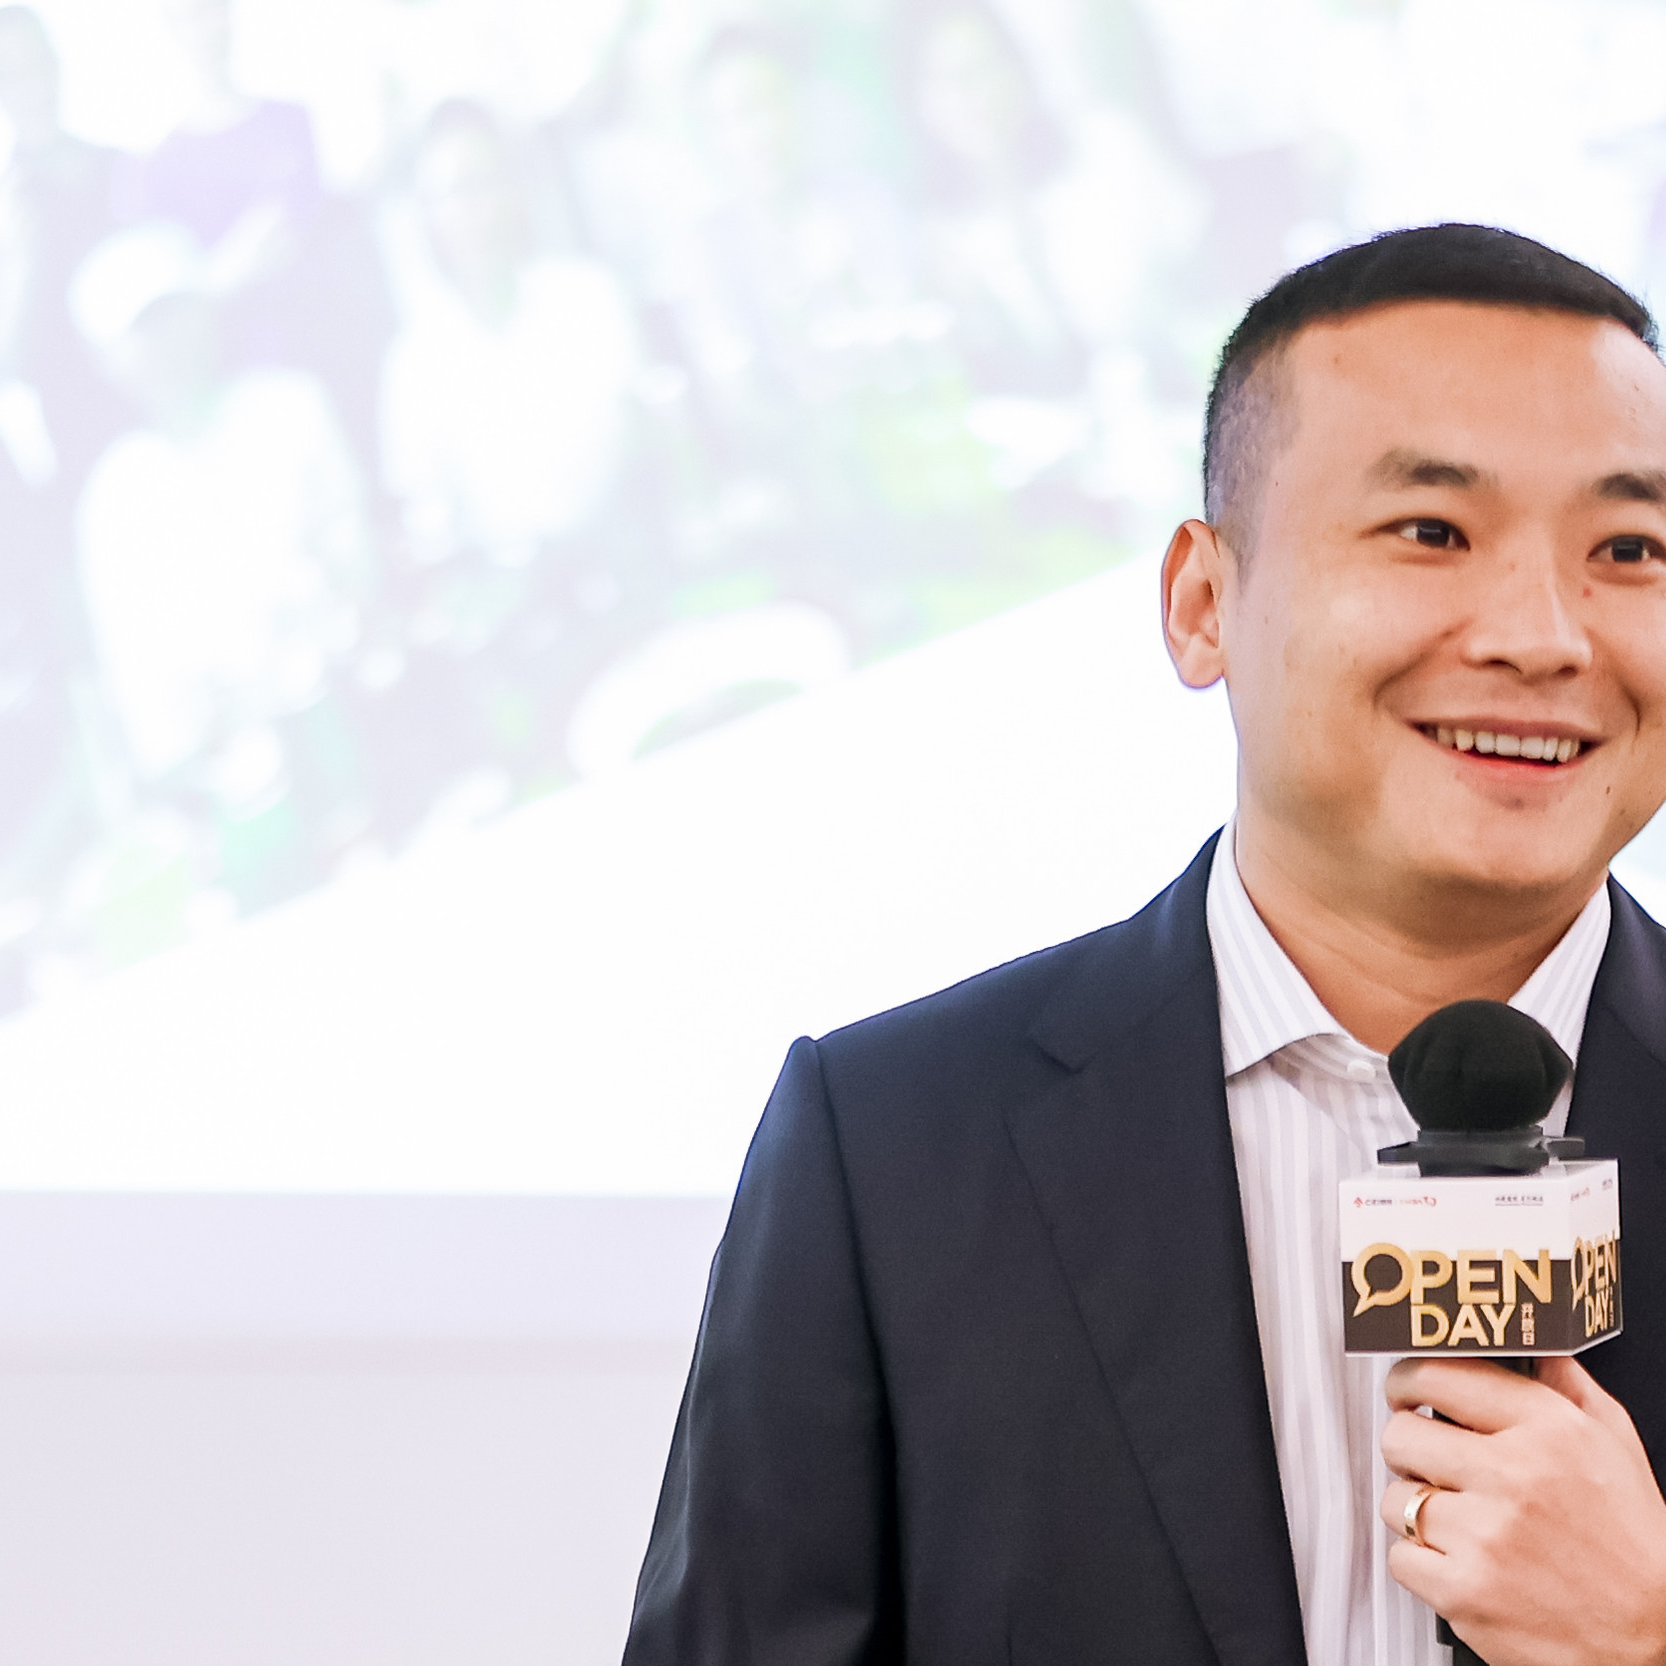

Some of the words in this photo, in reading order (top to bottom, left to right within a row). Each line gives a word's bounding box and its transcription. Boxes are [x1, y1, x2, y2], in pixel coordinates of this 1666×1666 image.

[1351, 1242, 1552, 1317] OPEN
[1571, 1229, 1617, 1311] OPEN
[1411, 1302, 1517, 1347] DAY
[1584, 1285, 1610, 1338] DAY
